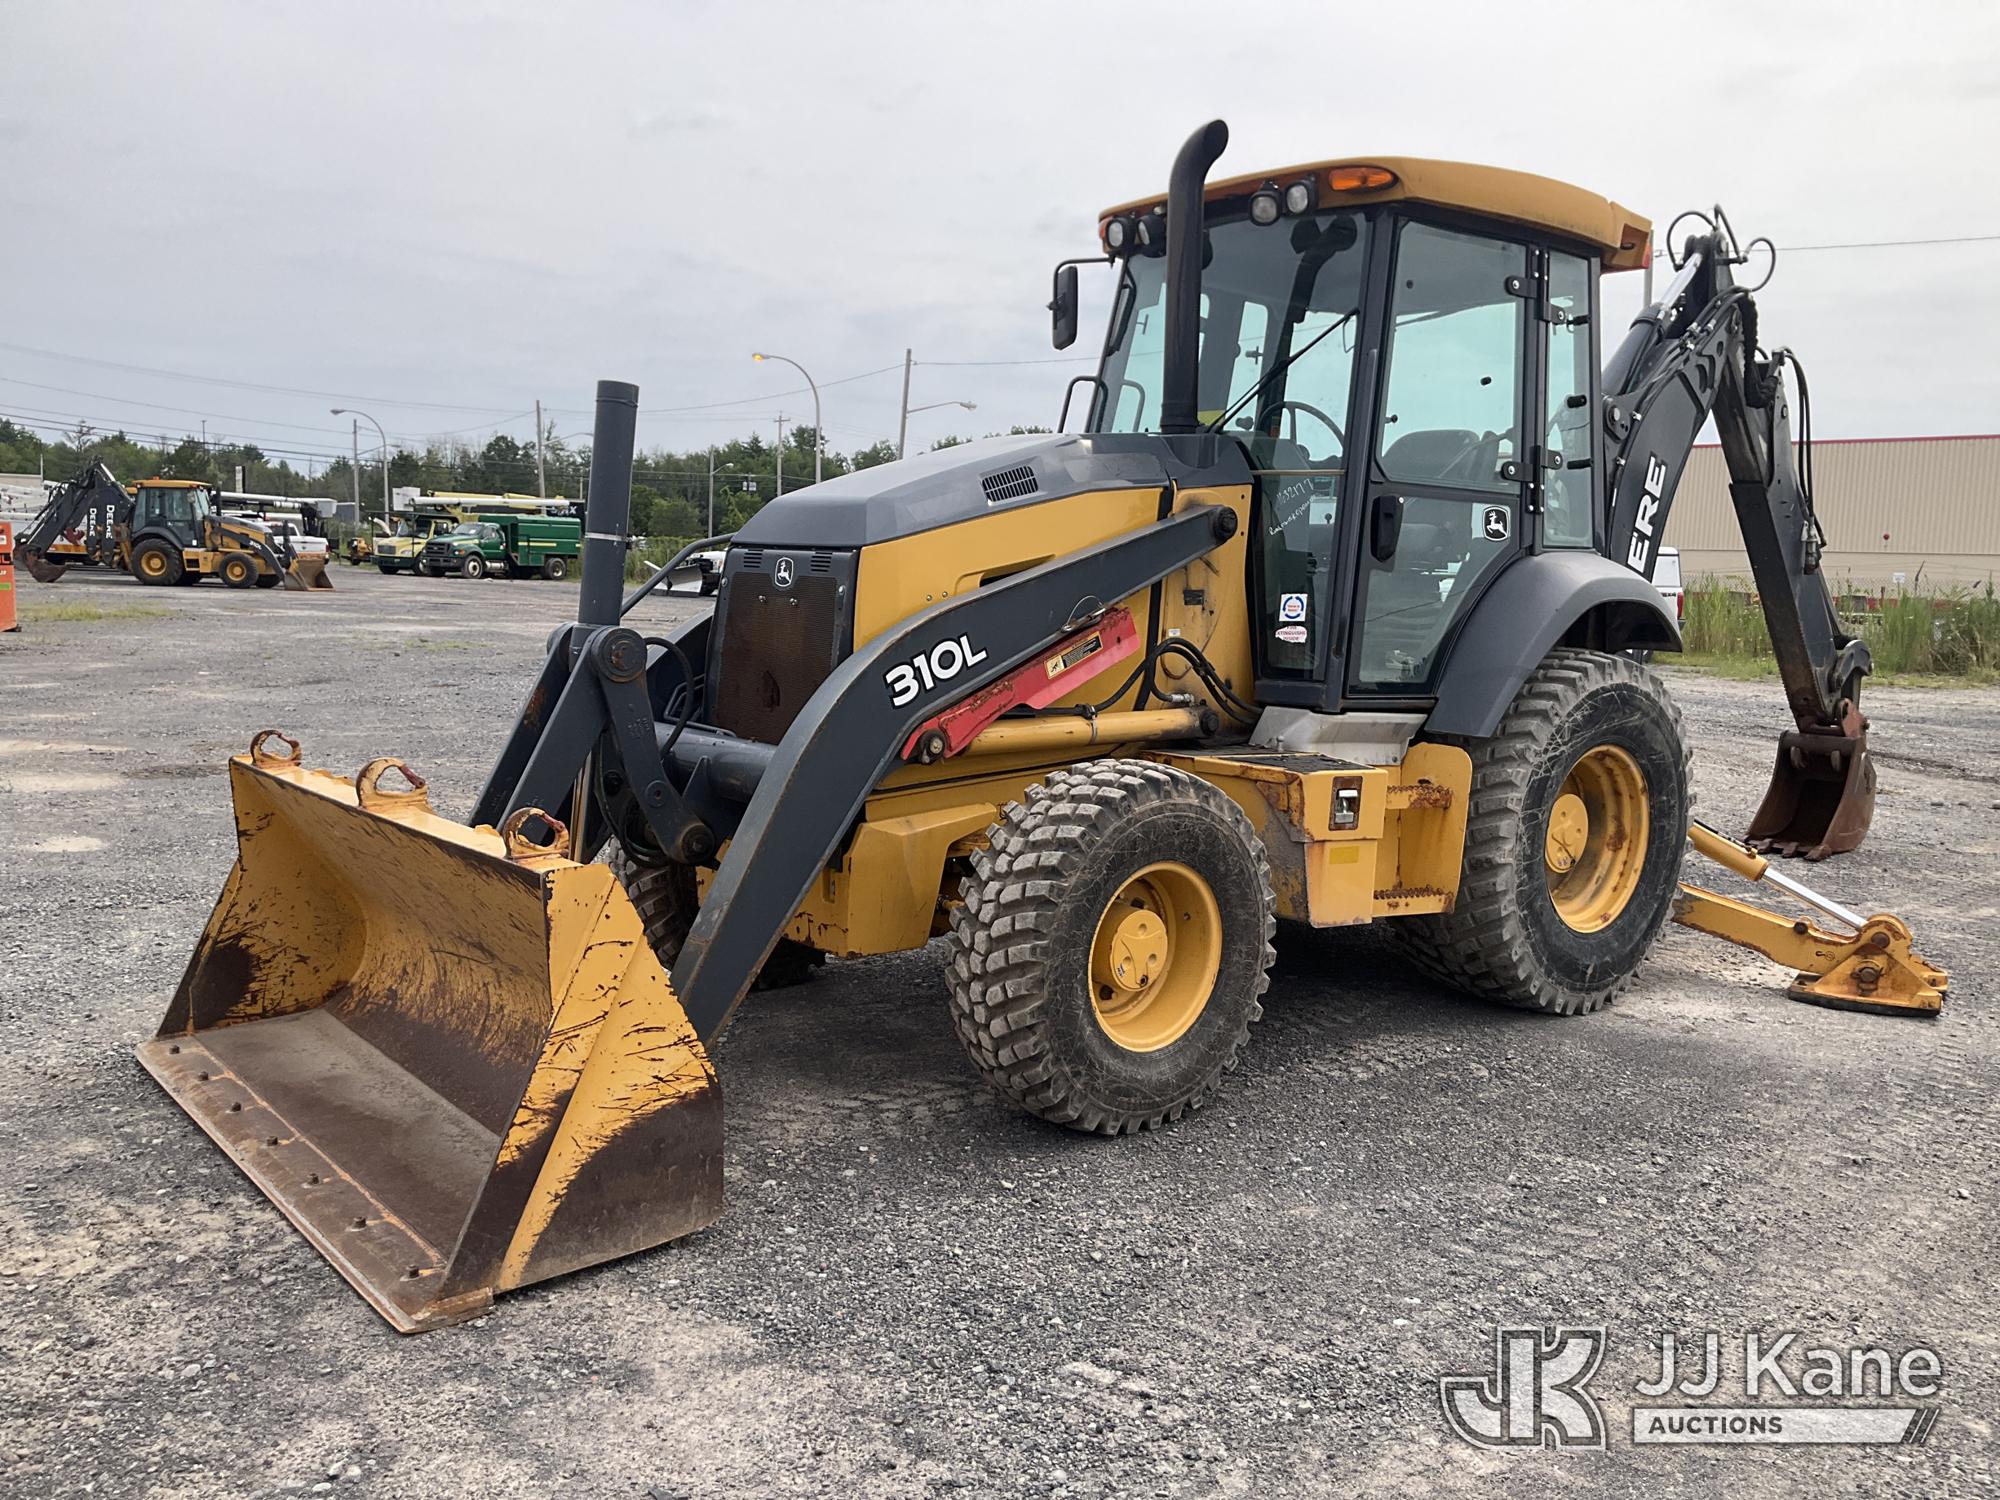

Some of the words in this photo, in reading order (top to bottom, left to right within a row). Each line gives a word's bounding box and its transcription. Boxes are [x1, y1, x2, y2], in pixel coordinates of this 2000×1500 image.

[89, 508, 97, 537] DEERE
[106, 504, 115, 539] DEERE
[885, 635, 987, 706] 310L
